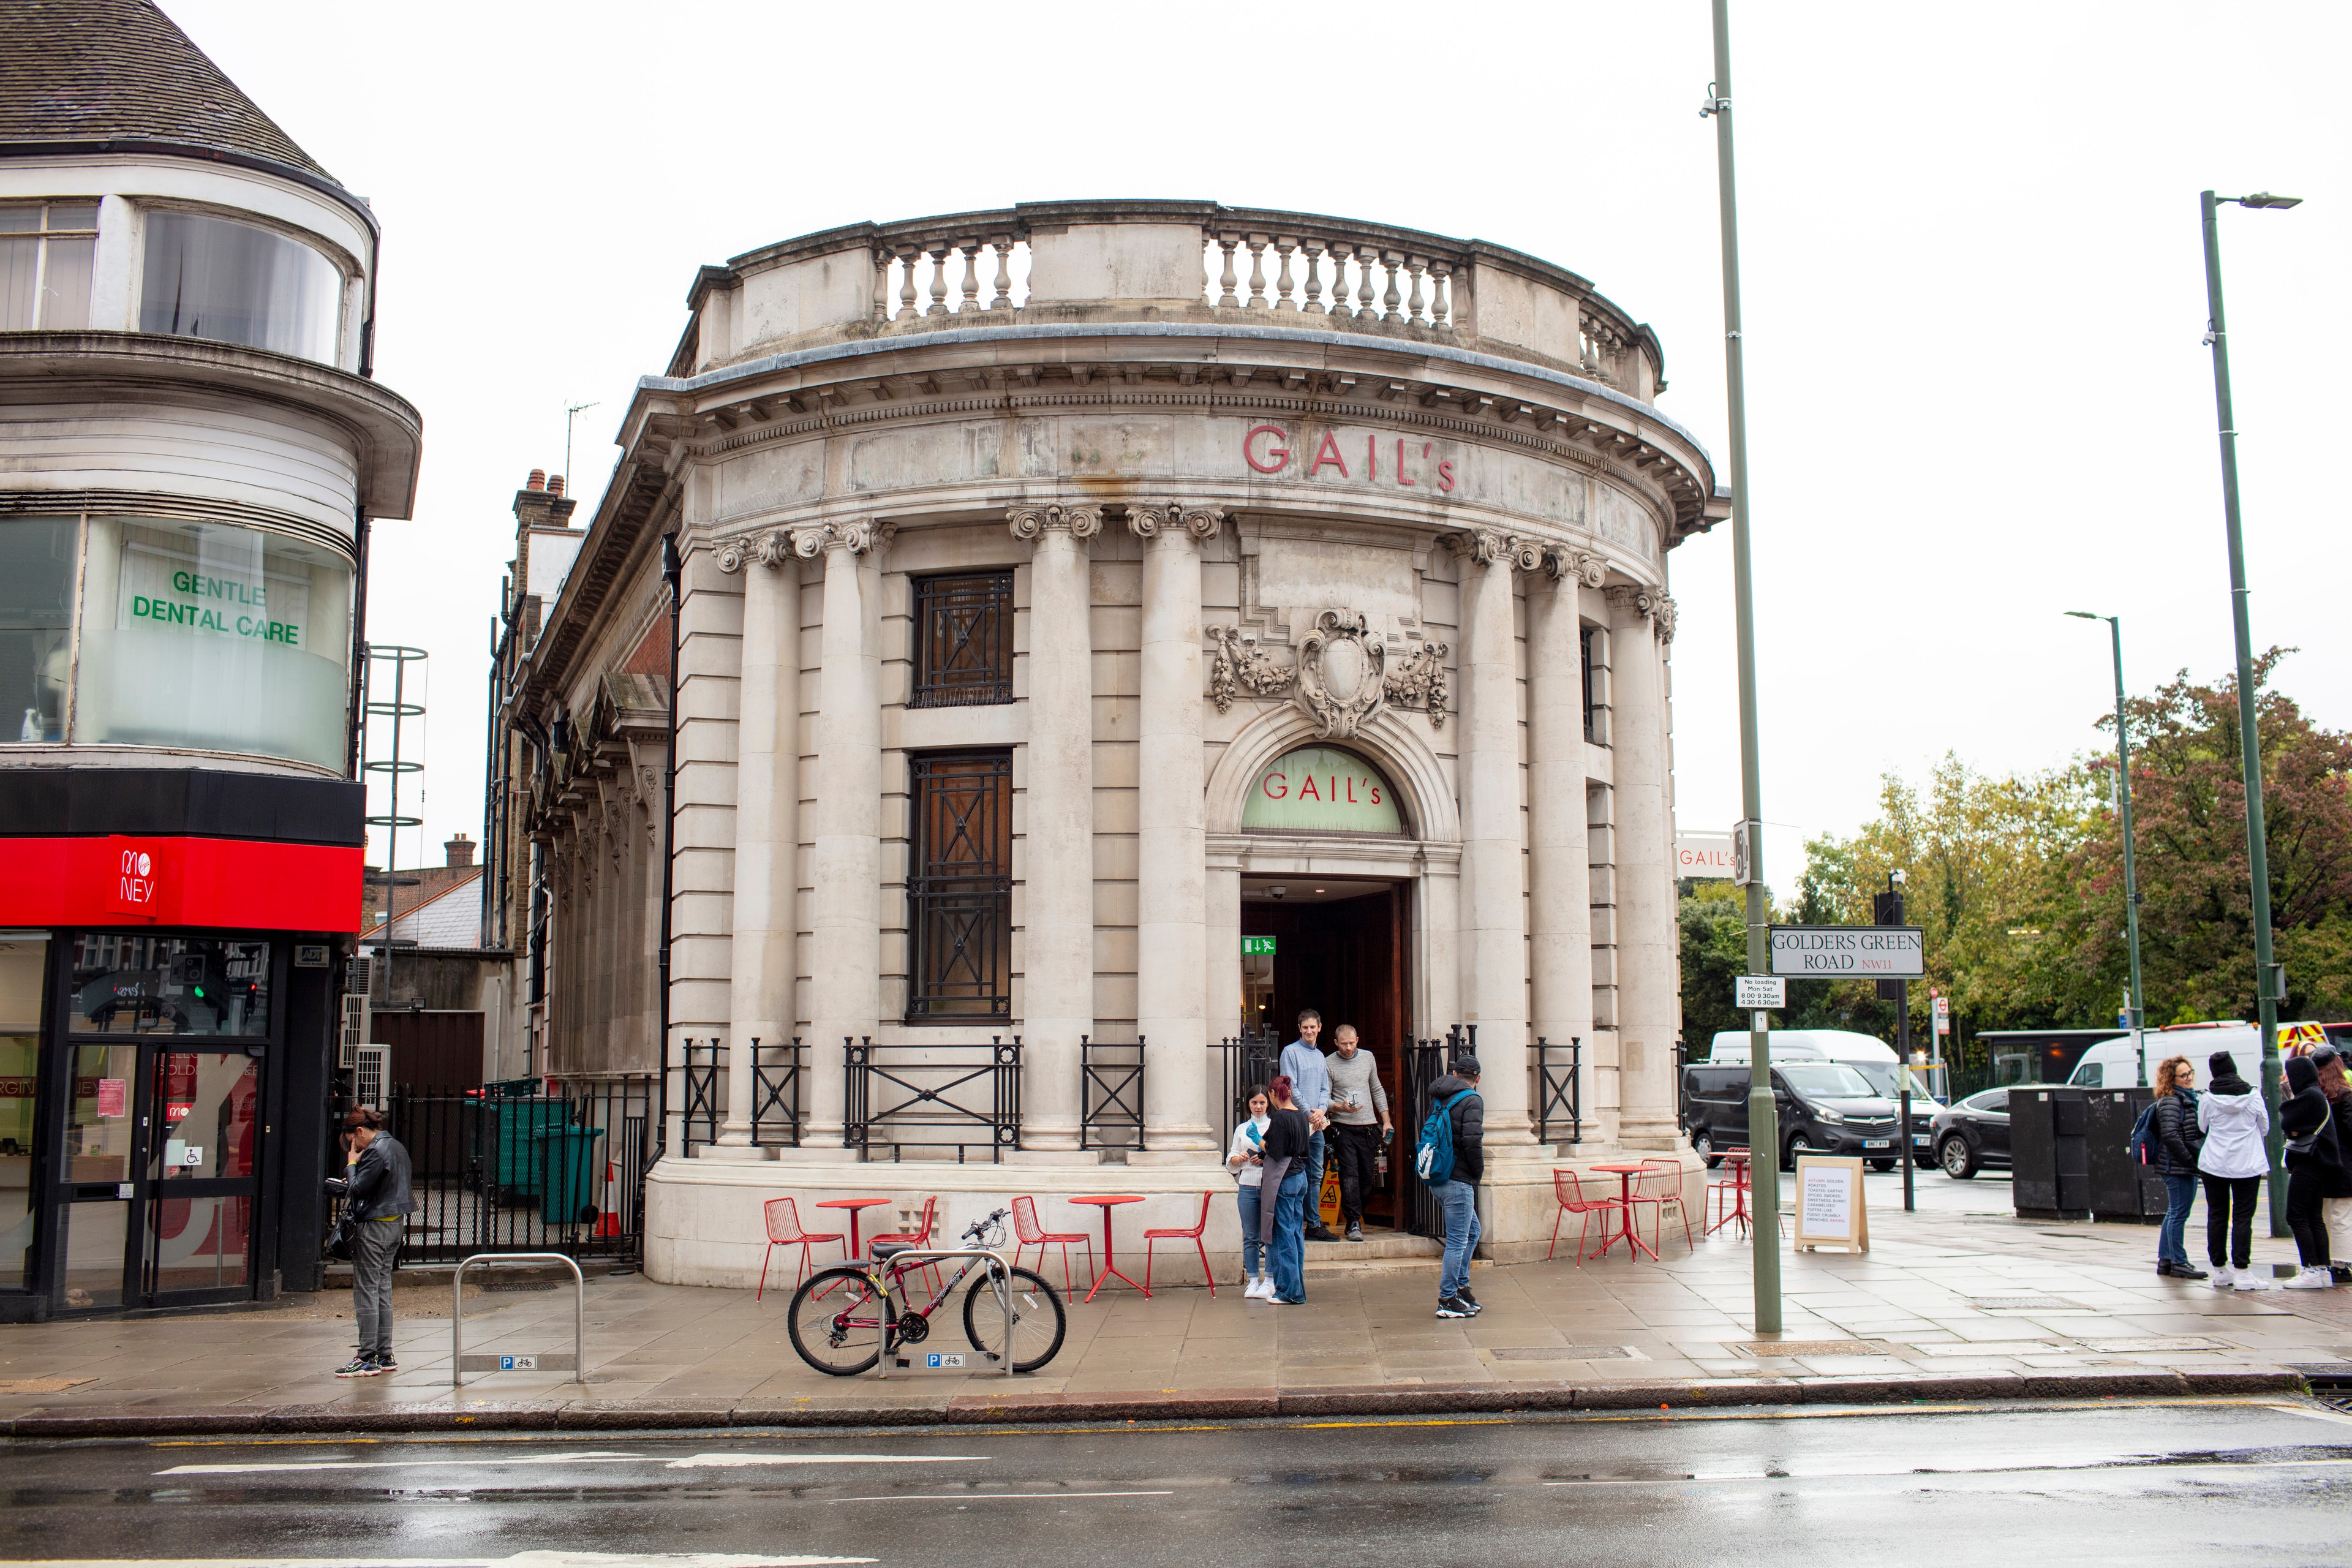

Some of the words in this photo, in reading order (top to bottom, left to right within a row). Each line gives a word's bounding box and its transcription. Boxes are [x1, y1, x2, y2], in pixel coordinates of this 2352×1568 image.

[1244, 425, 1455, 491] GAIL's
[173, 571, 266, 607] GENTLE
[133, 595, 229, 632] DENTAL
[236, 616, 299, 645] CARE
[1263, 772, 1381, 805] GAIL's
[1679, 850, 1735, 866] GAIL's
[1772, 934, 1856, 949] GOLDERS
[1861, 935, 1921, 950] GREEN
[303, 949, 323, 960] ADT
[1804, 954, 1854, 969] ROAD
[1862, 960, 1893, 969] NW11
[503, 1357, 511, 1368] P
[930, 1355, 938, 1366] P
